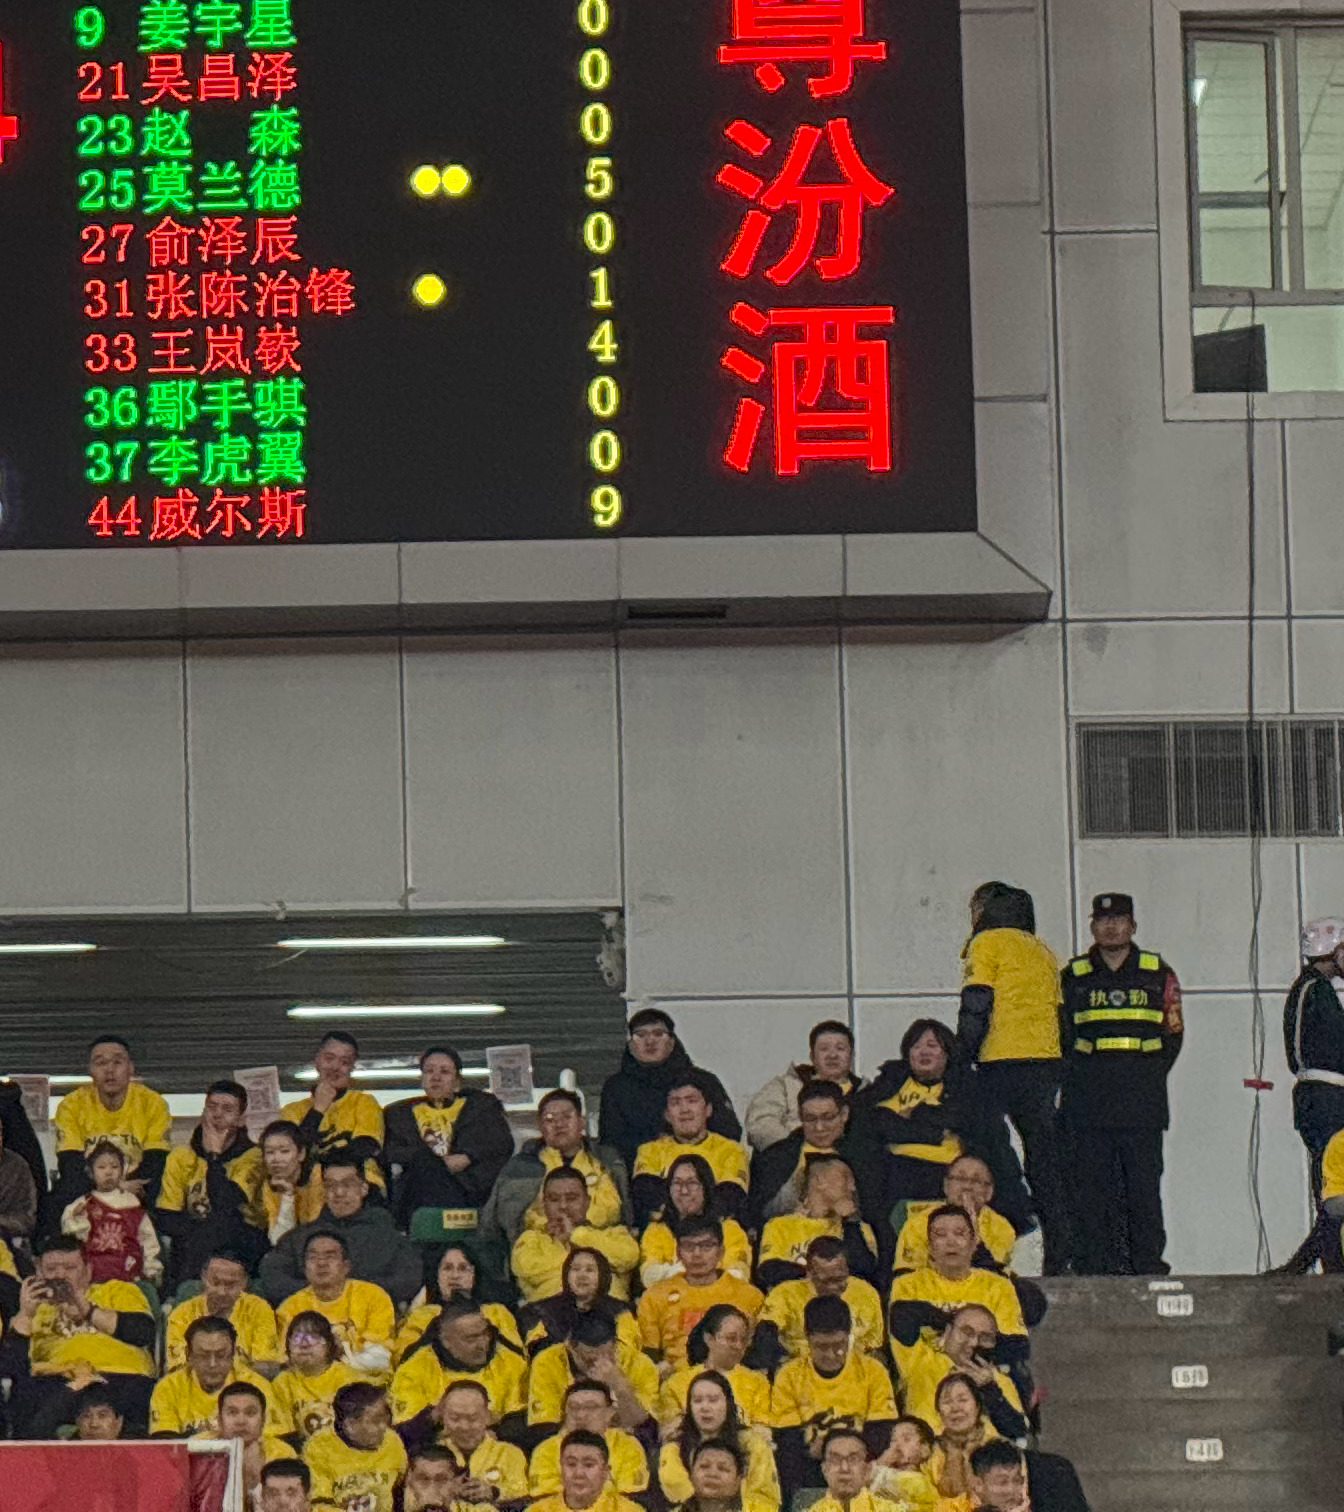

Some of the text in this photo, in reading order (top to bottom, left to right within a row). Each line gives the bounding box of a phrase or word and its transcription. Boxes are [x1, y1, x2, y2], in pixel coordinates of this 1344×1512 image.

[74, 6, 105, 48] 9
[77, 49, 611, 105] 21 吴昌泽 0
[77, 115, 133, 156] 23
[582, 103, 612, 146] 0
[78, 158, 614, 213] 25 莫兰德 5
[80, 213, 616, 265] 27 俞泽辰 0
[84, 268, 614, 319] 31 张陈治锋 1
[85, 334, 136, 372] 33
[589, 320, 619, 364] 4
[84, 387, 137, 427] 36
[588, 376, 620, 419] 0
[85, 431, 622, 485] 37 李虎翼 0
[87, 486, 623, 540] 44 威尔斯 9
